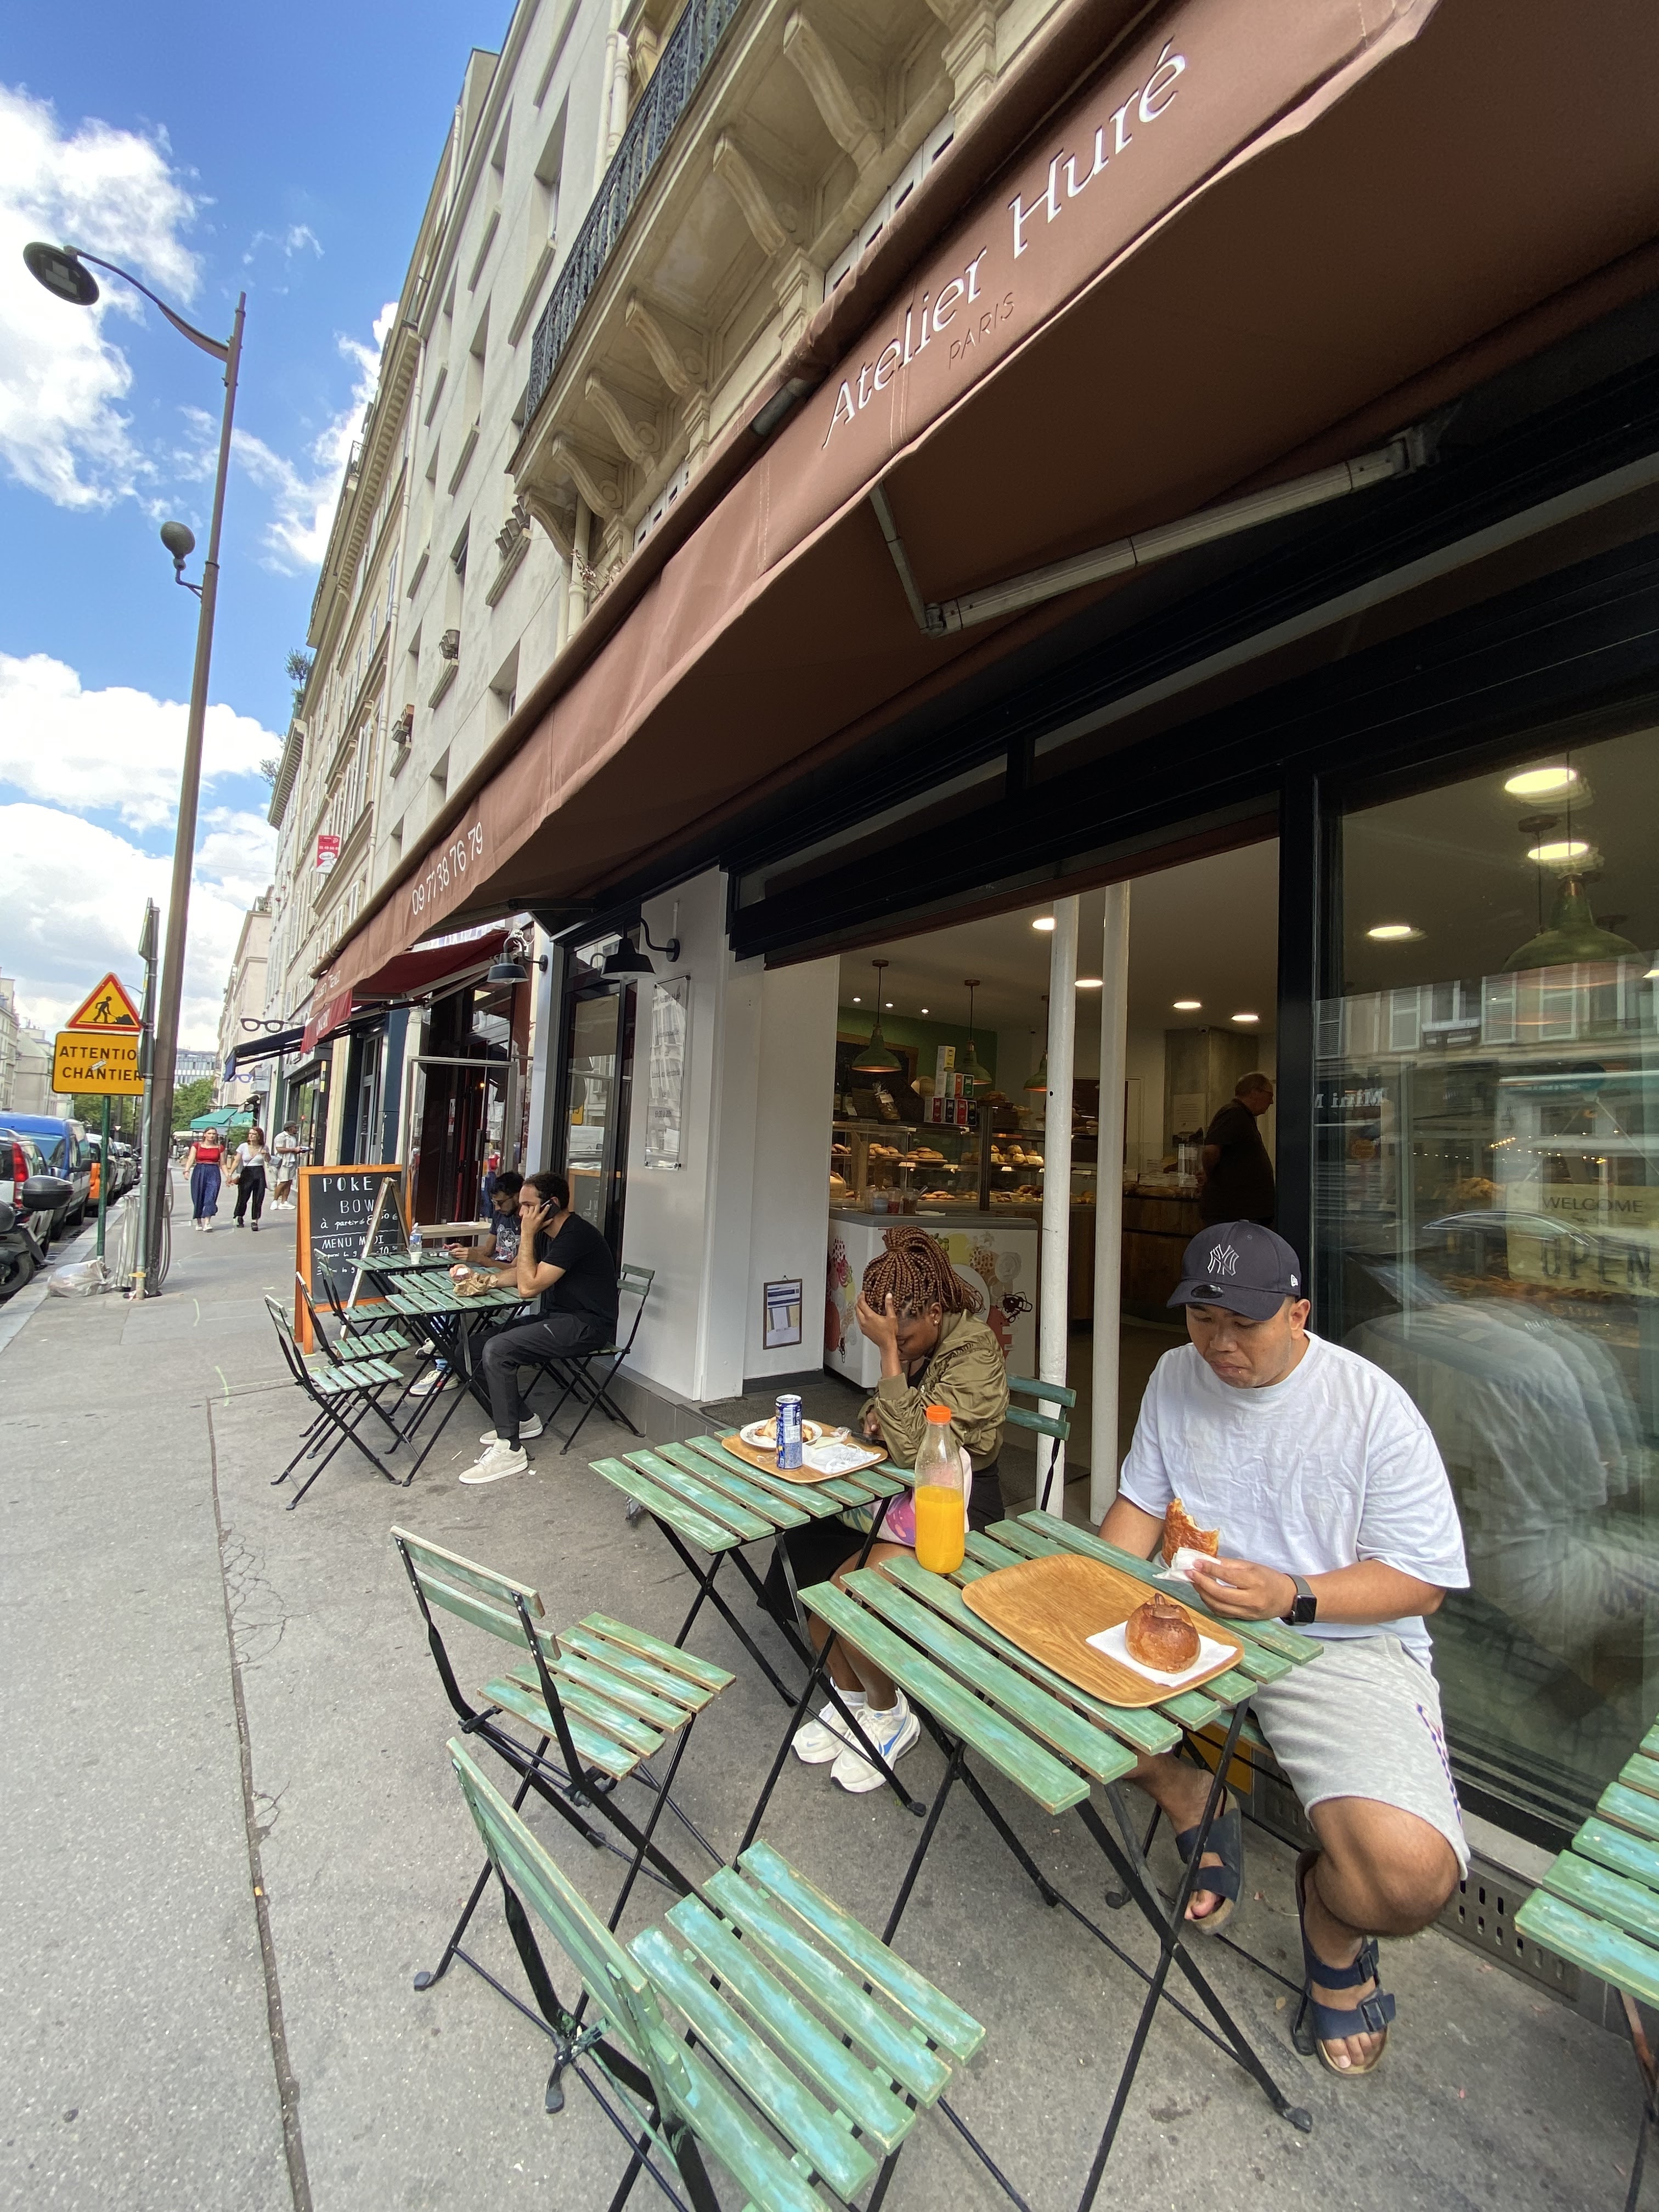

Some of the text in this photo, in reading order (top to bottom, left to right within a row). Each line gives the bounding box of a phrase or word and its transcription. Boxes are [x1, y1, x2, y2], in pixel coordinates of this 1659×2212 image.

[821, 35, 1187, 450] Atelier Huré
[949, 292, 1014, 370] PARIS
[412, 821, 483, 916] 09 77 38 76 79
[59, 1046, 137, 1061] ATTENTIO
[62, 1066, 143, 1081] CHANTIER
[340, 1199, 387, 1214] BOW
[1543, 1197, 1644, 1213] WELCOME
[320, 1217, 329, 1229] à
[334, 1220, 359, 1231] partir
[321, 1234, 385, 1250] MENU MI
